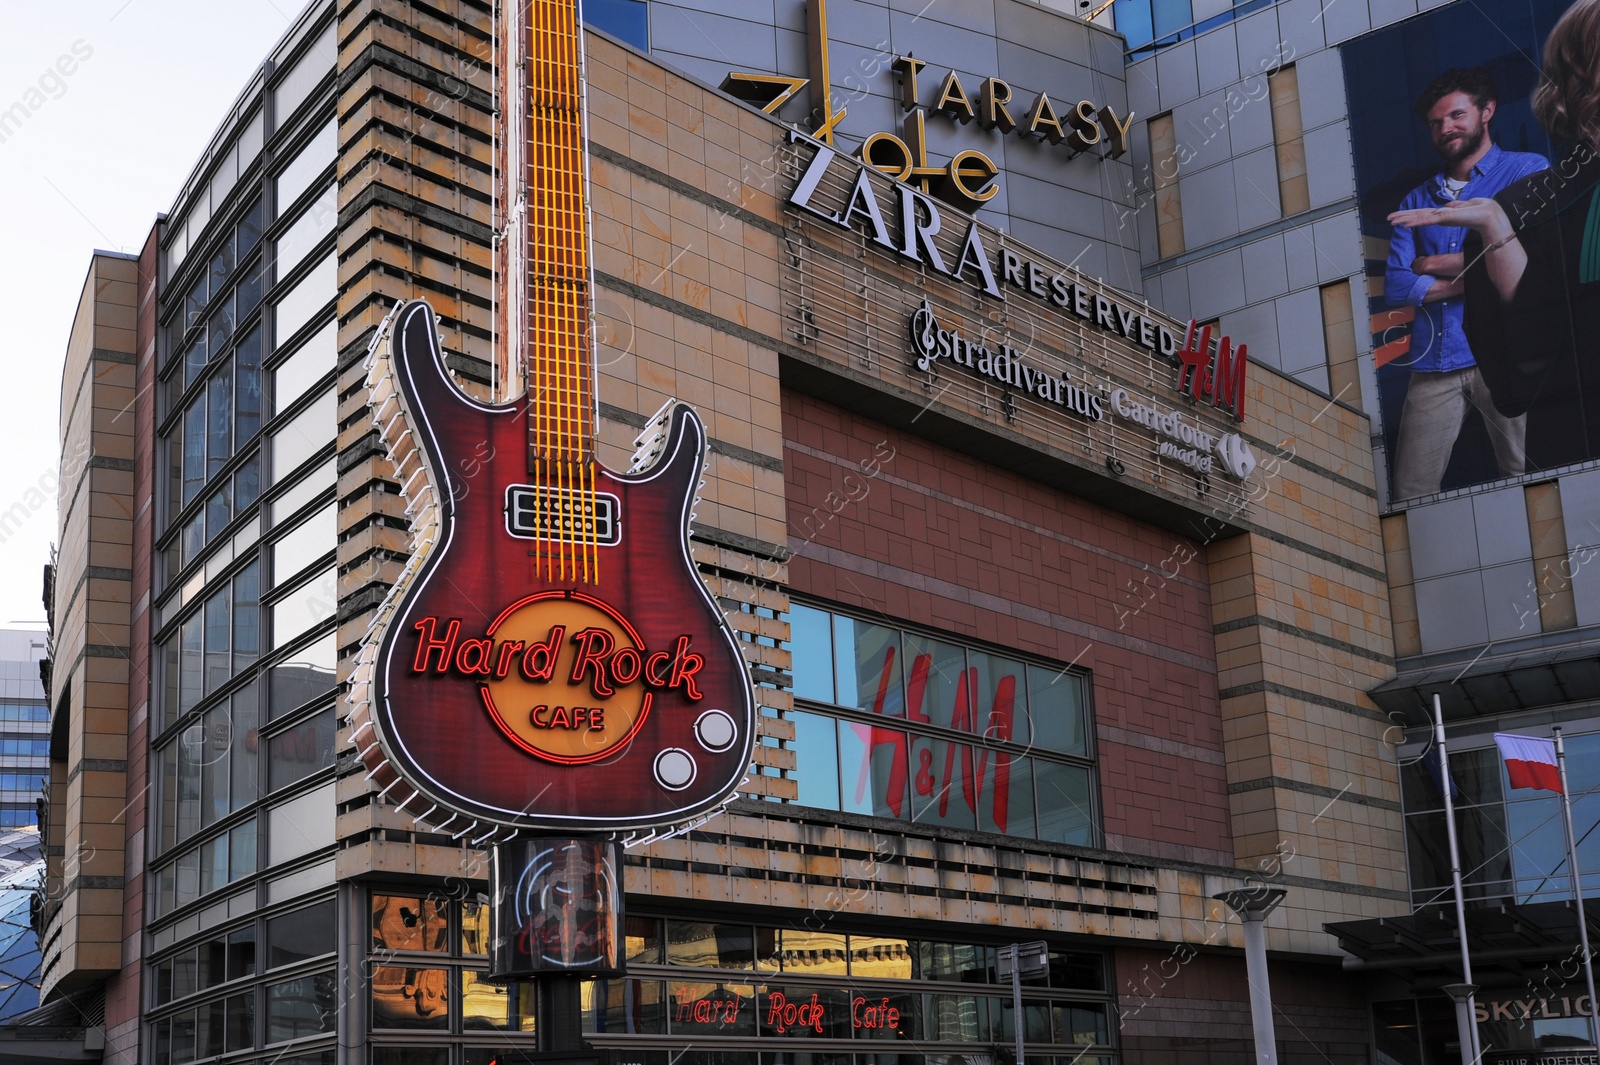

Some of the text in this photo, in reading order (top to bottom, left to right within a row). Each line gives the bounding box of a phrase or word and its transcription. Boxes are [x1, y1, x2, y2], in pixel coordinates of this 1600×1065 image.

[897, 54, 1136, 156] TARASY
[788, 130, 1005, 300] ZARA
[1000, 249, 1177, 357] RESERVED
[936, 328, 1104, 422] stradivarius
[1177, 318, 1248, 423] H&M
[1111, 388, 1214, 453] Carrefour
[1160, 441, 1214, 475] market
[411, 616, 706, 702] Hard Rock
[530, 705, 606, 730] CAFE
[850, 647, 1017, 834] H&M
[676, 987, 901, 1034] Hard Rock Cafe
